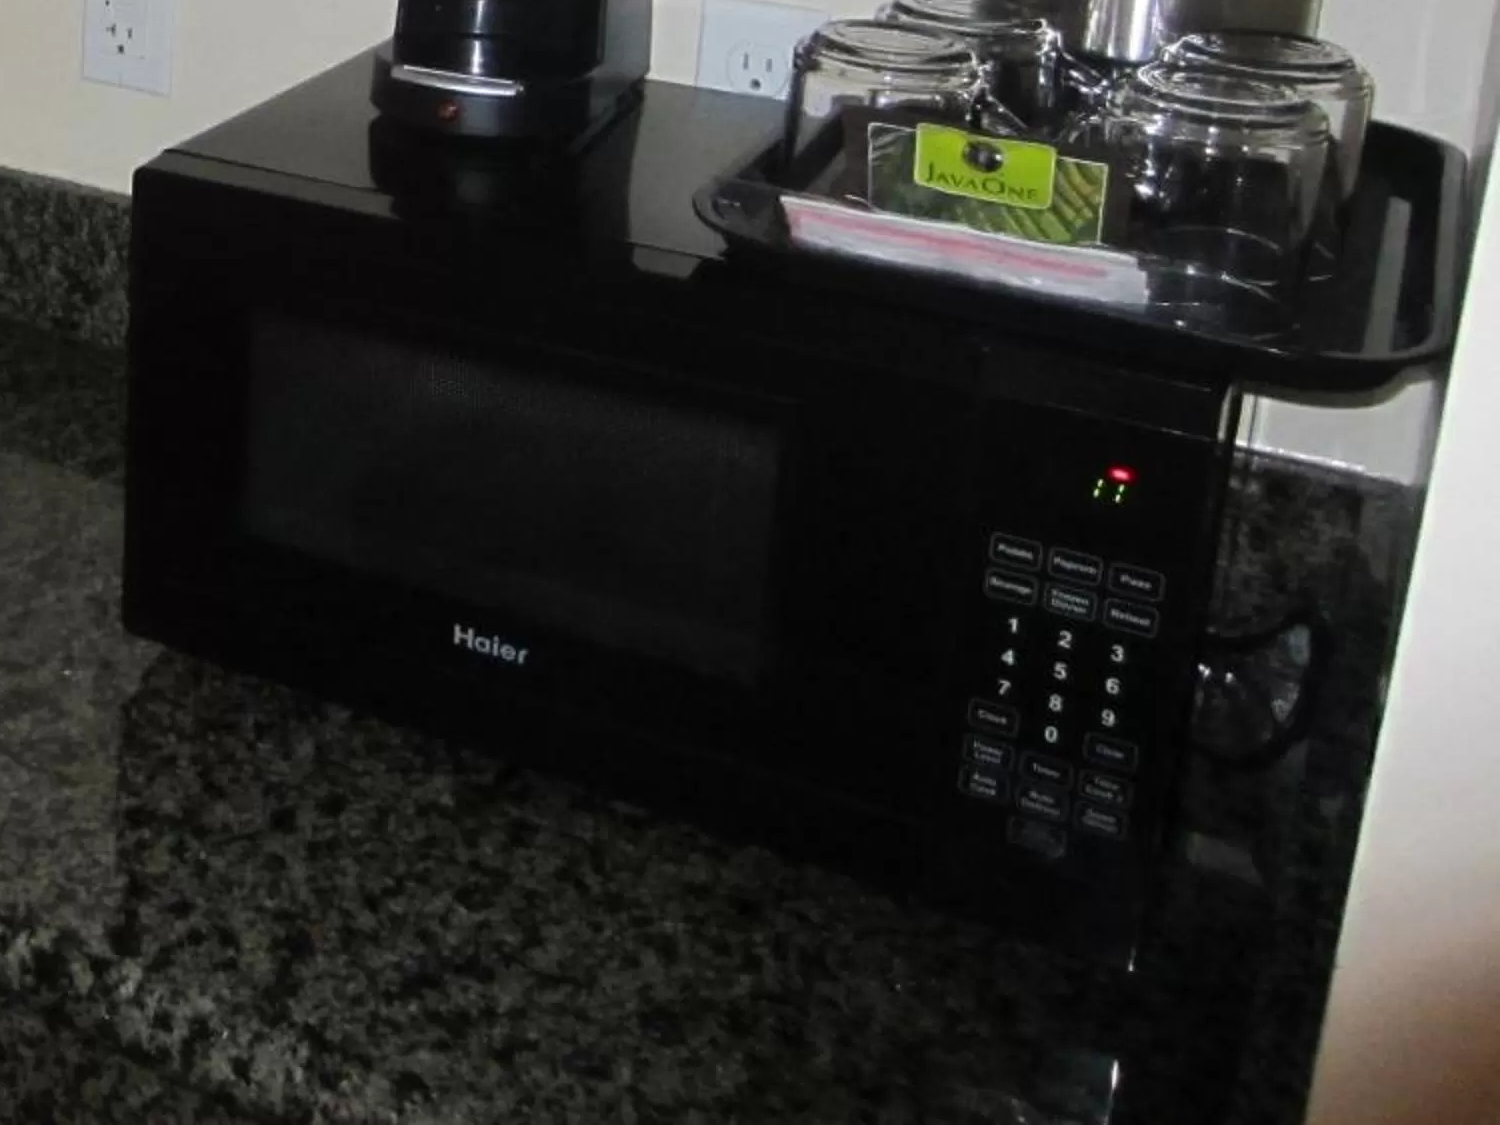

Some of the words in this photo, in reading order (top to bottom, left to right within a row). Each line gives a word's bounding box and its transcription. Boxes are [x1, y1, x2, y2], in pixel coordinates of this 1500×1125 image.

[453, 623, 529, 665] Haier
[1007, 616, 1019, 634] 1
[1057, 629, 1073, 650] 2
[1109, 643, 1125, 663] 3
[1000, 648, 1015, 666] 4
[1052, 660, 1068, 681] 5
[1104, 676, 1121, 695] 6
[997, 677, 1012, 695] 7
[1048, 693, 1064, 712] 8
[1100, 707, 1116, 727] 9
[1043, 725, 1060, 744] 0
